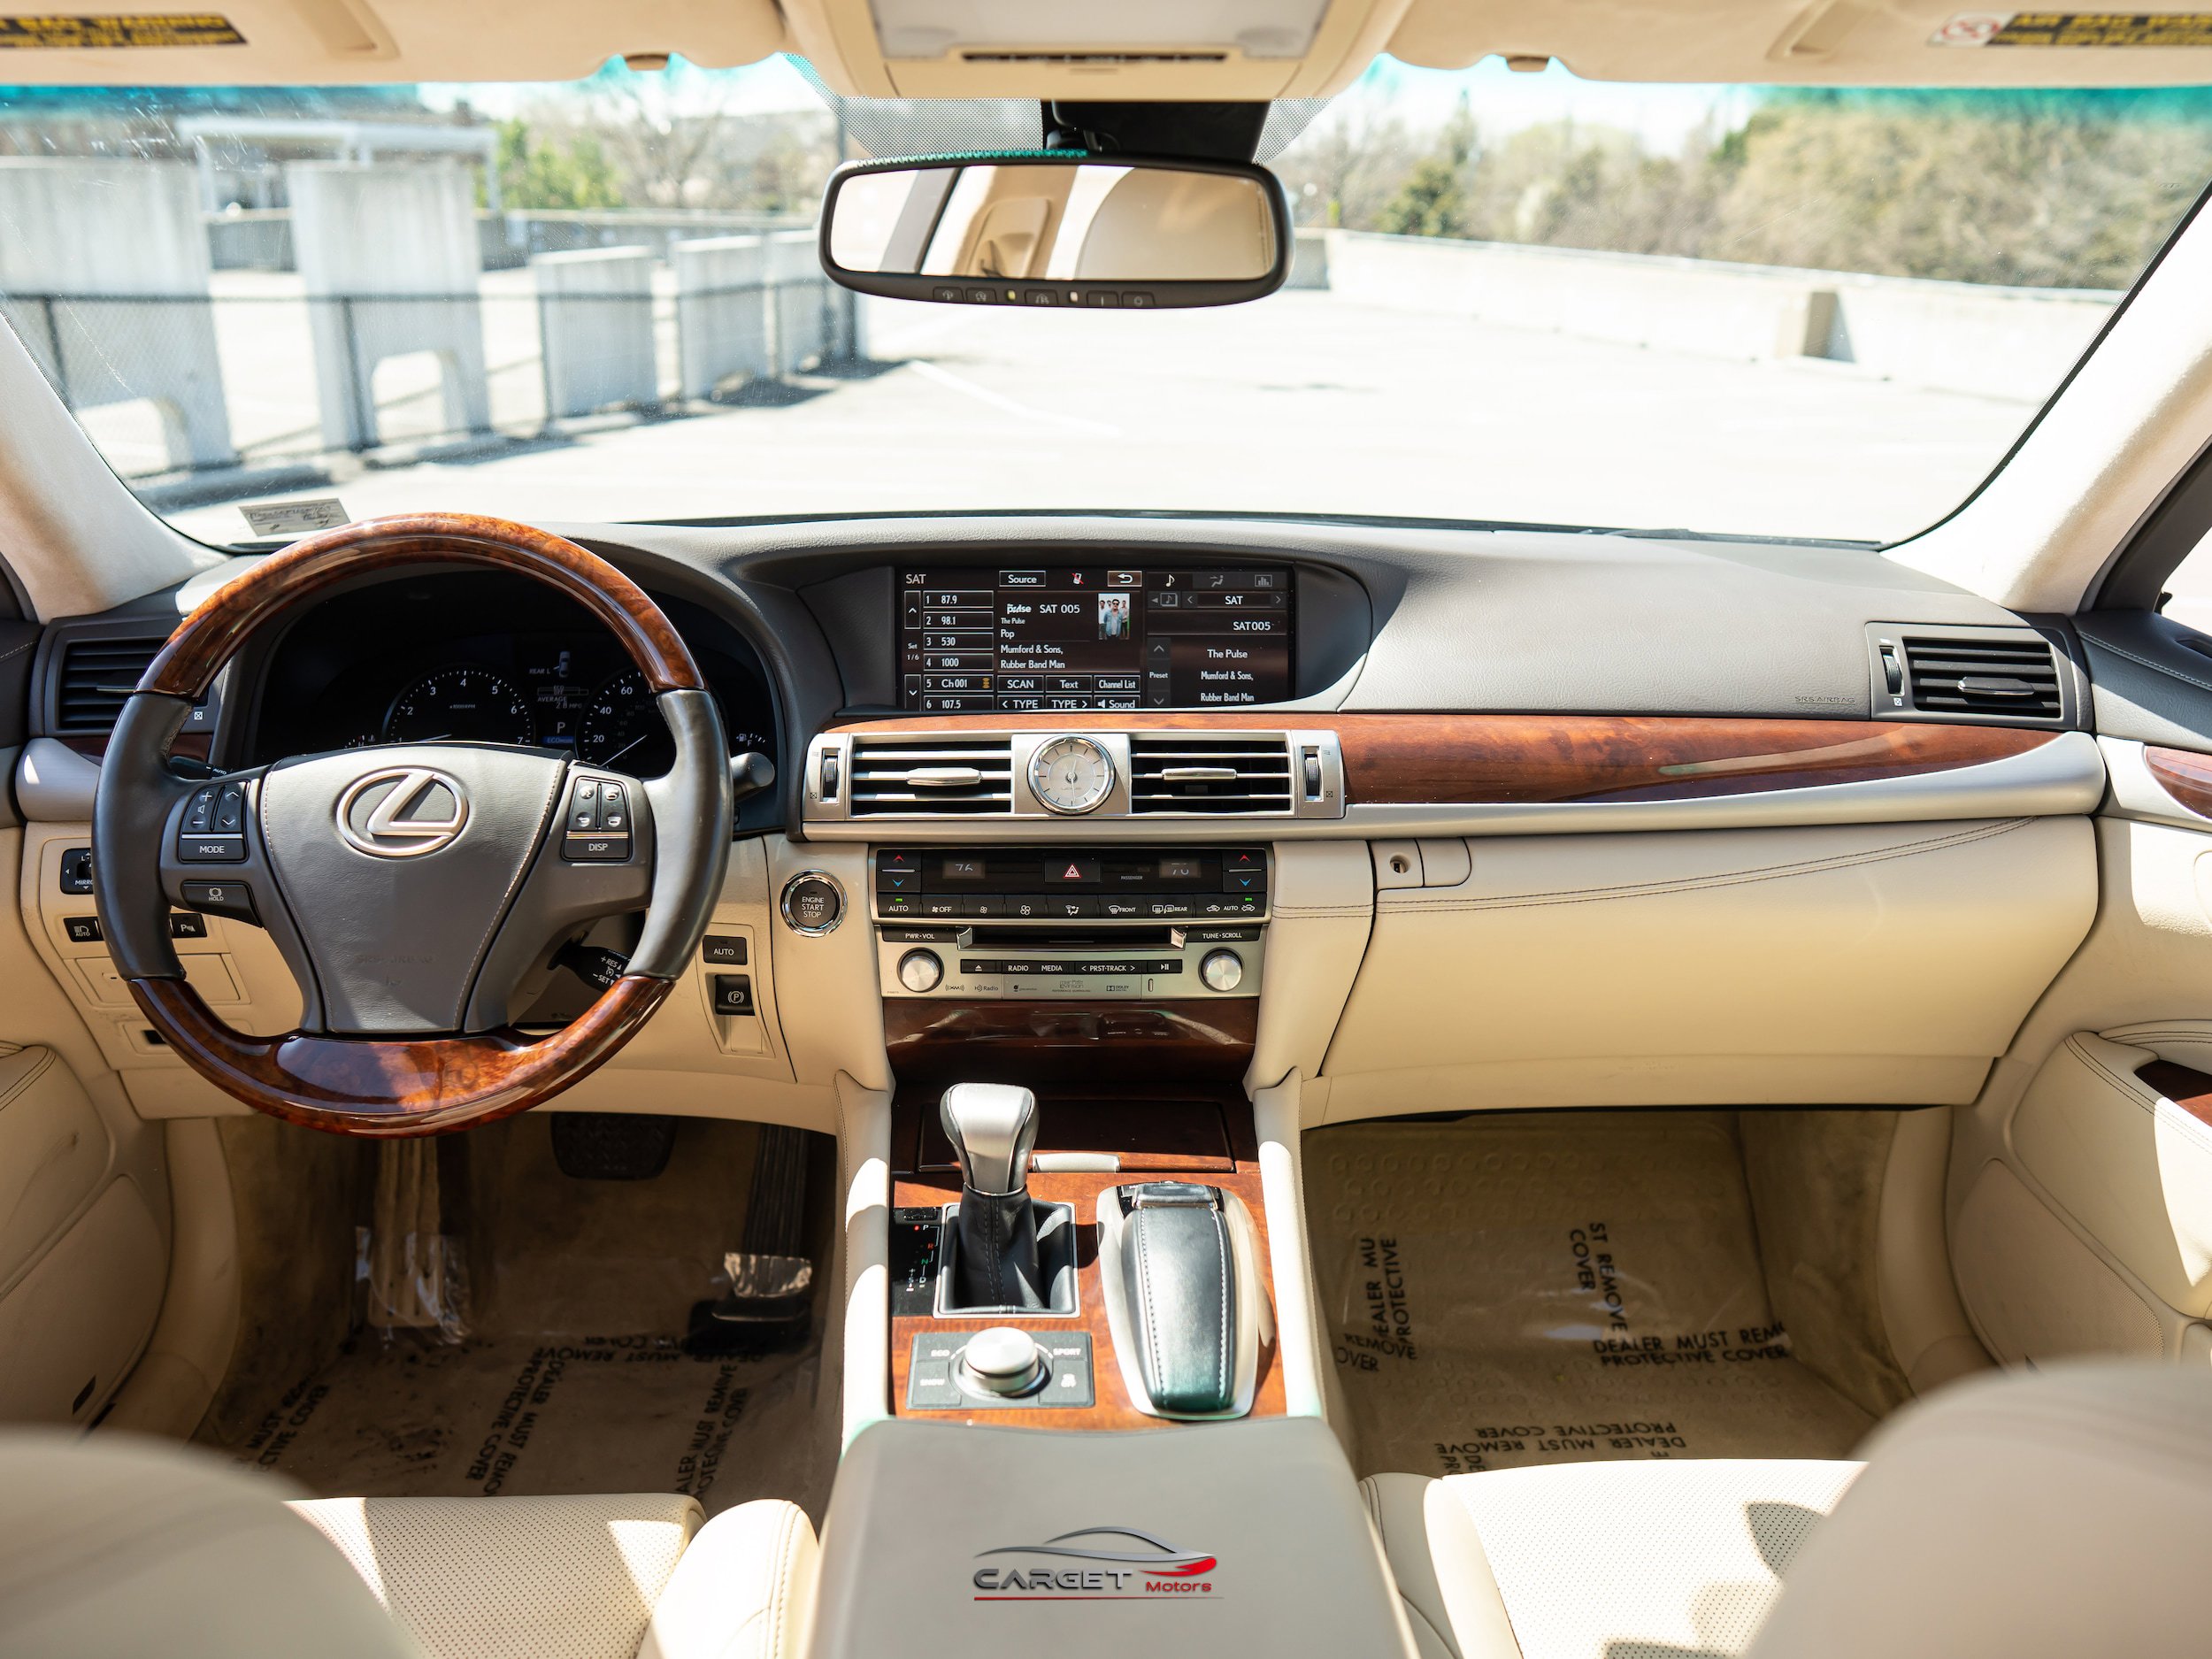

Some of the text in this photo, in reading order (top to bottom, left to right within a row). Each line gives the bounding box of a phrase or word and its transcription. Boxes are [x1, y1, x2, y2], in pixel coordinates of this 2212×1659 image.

[906, 574, 926, 584] SAT
[1008, 575, 1037, 584] Source
[941, 595, 957, 604] 87.9
[1225, 595, 1243, 605] SAT
[1040, 604, 1057, 613] SAT
[1061, 604, 1080, 613] 005
[1001, 628, 1015, 640] Pop
[926, 637, 956, 646] 3 530
[1001, 644, 1064, 656] Mumford & Sons,
[1207, 649, 1248, 658] The Pulse
[926, 658, 959, 667] 4 1000
[1001, 660, 1065, 669] Rubber Band Man
[1201, 671, 1254, 681] Mumford & Sons,
[459, 679, 467, 687] 4
[926, 680, 932, 688] 5
[1007, 680, 1034, 688] SCAN
[1059, 680, 1079, 688] Text
[1098, 680, 1136, 689] Channel List
[429, 687, 436, 696] 3
[491, 686, 498, 695] 5
[620, 687, 633, 695] 60
[1201, 693, 1255, 702] Rubber Band Man
[926, 700, 961, 709] 6 107.5
[1012, 699, 1039, 709] TYPE
[1051, 699, 1077, 709] TYPE
[1109, 700, 1136, 709] Sound
[407, 706, 414, 715] 2
[511, 705, 517, 715] 6
[599, 706, 612, 715] 40
[557, 722, 566, 733] P
[518, 736, 524, 745] 7
[593, 734, 605, 743] 20
[199, 845, 226, 855] MODE
[588, 842, 609, 852] DISP
[713, 948, 734, 956] AUTO
[605, 958, 618, 969] RES
[597, 974, 611, 985] SET
[1570, 1228, 1596, 1292] COVER
[1590, 1223, 1629, 1333] ST REMOVE
[1594, 1335, 1664, 1355] DEALER
[1677, 1329, 1730, 1350] MUST
[1053, 1348, 1081, 1356] SPORT
[1601, 1344, 1790, 1368] PROTECTIVE COVER
[507, 1411, 539, 1449] MUST
[1475, 1422, 1678, 1440] PROTECTIVE COVER
[1434, 1436, 1686, 1455] DEALER MUST REMOVE
[465, 1433, 502, 1481] COVER
